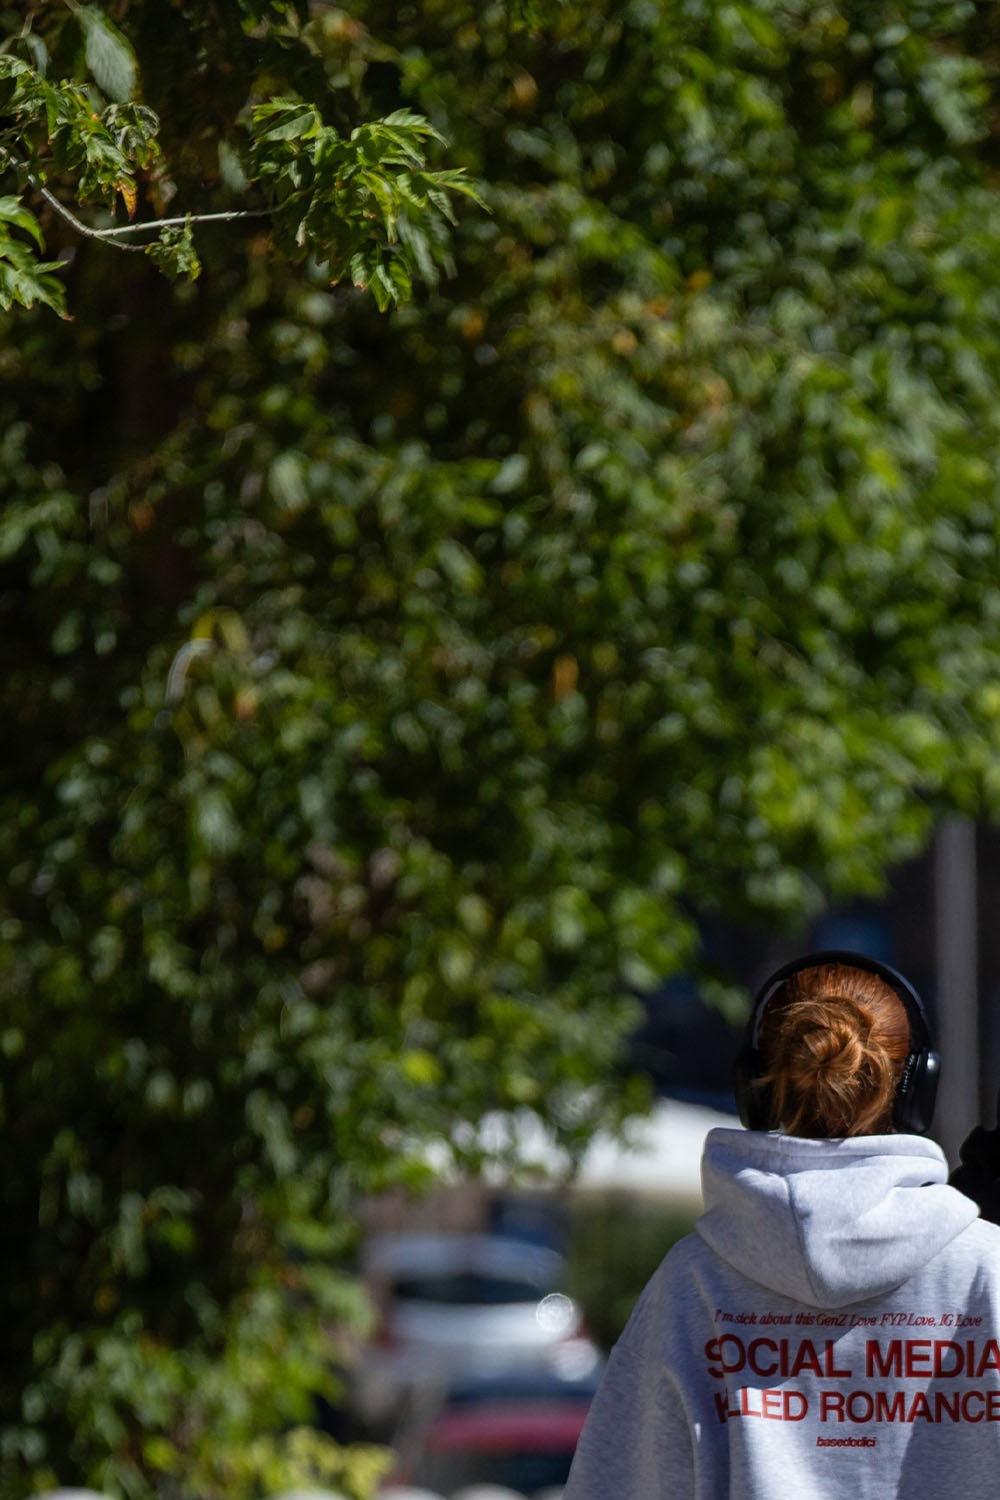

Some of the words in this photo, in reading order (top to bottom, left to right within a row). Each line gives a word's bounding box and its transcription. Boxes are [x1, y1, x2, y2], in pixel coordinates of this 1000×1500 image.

[714, 1308, 734, 1323] I'm
[735, 1311, 757, 1326] sick
[759, 1310, 793, 1326] about
[794, 1311, 816, 1326] this
[849, 1312, 877, 1328] Love
[879, 1311, 907, 1328] FYP
[906, 1312, 937, 1328] Love,
[939, 1312, 955, 1328] IG
[956, 1313, 983, 1328] Love
[704, 1332, 852, 1379] SOCIAL
